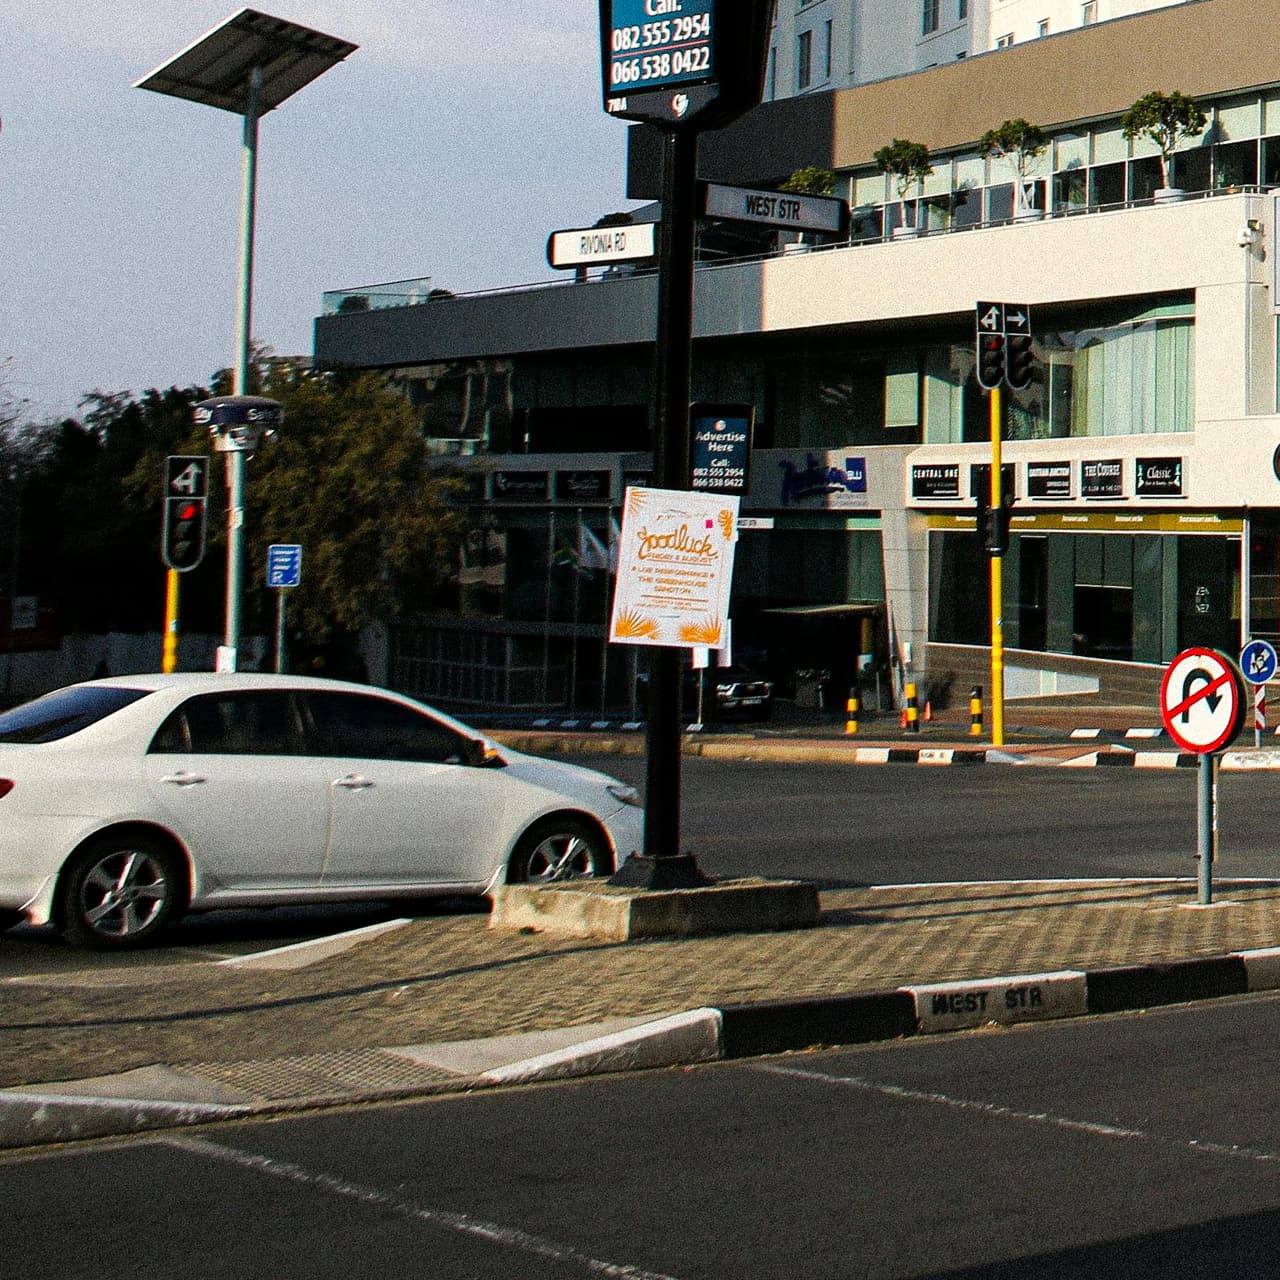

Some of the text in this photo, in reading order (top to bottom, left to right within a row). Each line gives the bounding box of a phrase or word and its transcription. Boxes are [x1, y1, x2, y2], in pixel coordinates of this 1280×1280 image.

[611, 12, 710, 52] 082 555 2954
[611, 46, 710, 85] 066 538 0422
[746, 195, 801, 221] WEST STR
[579, 232, 627, 255] RIVONIA RD
[695, 431, 747, 442] Advertise
[708, 441, 735, 452] Here
[711, 459, 731, 468] Call:
[1147, 465, 1171, 479] Classic
[930, 986, 1042, 1016] WEST STR
